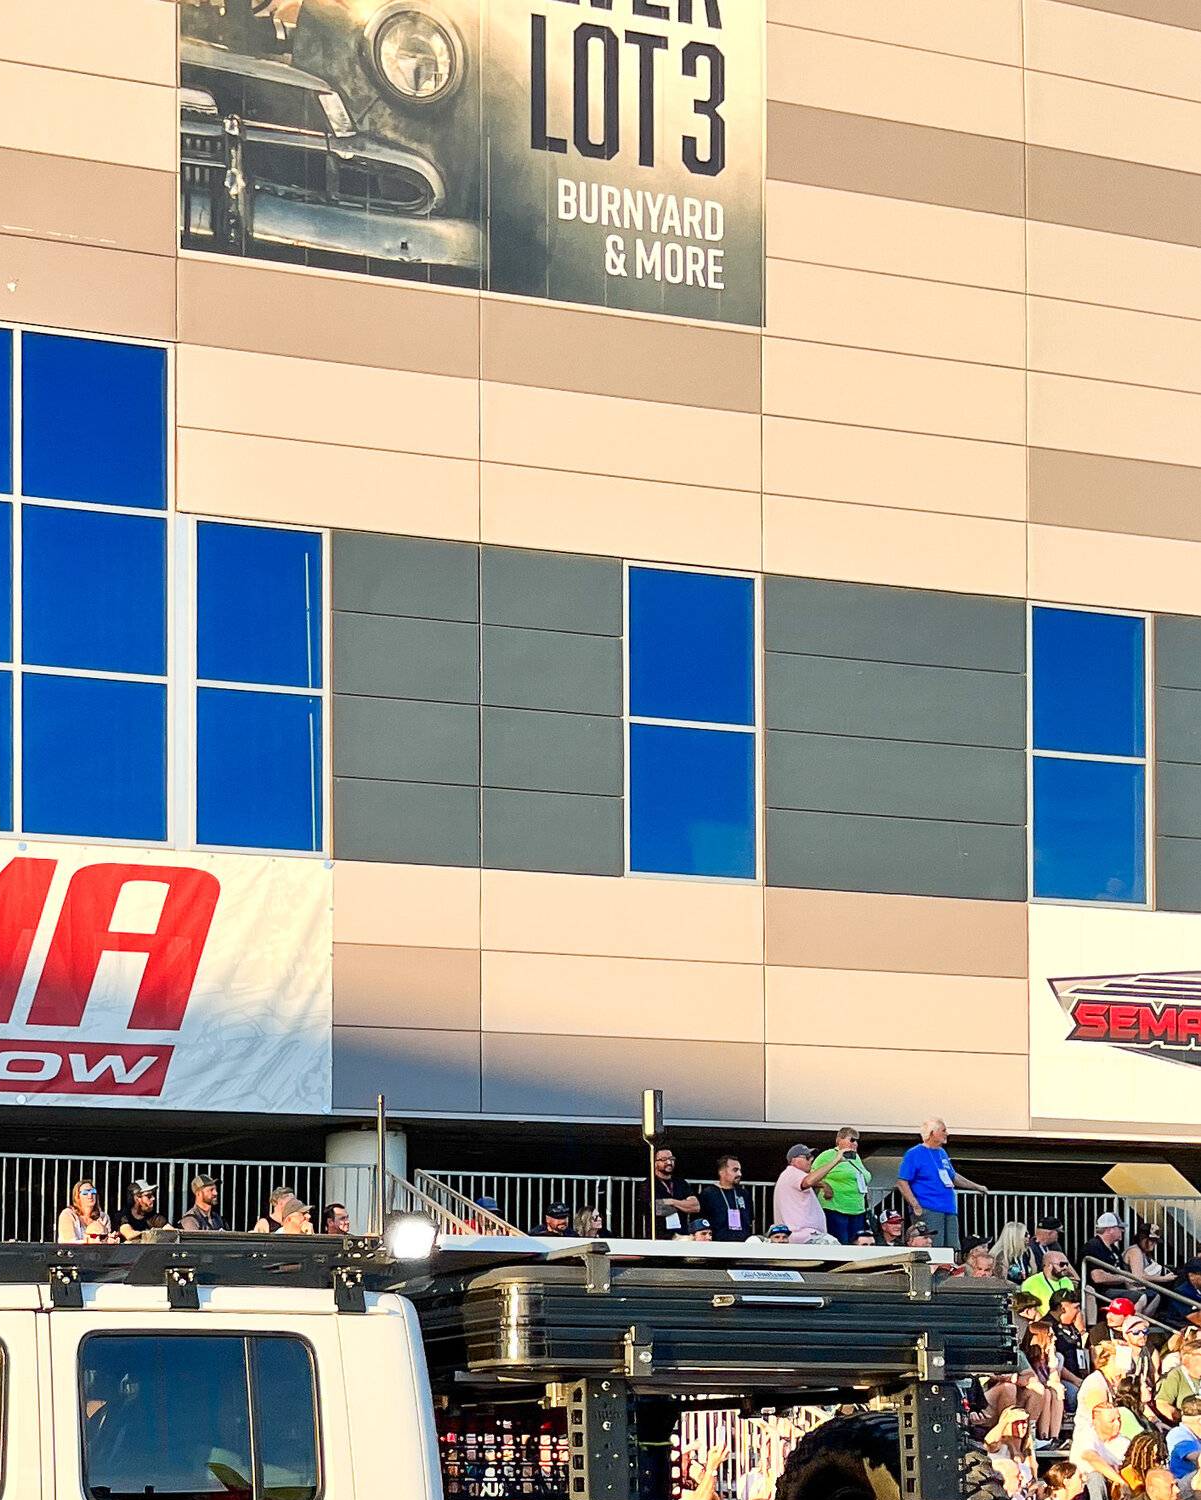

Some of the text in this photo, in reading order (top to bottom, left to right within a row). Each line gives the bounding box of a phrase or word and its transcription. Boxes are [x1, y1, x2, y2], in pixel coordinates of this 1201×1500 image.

[530, 13, 725, 177] LOT 3
[557, 178, 725, 241] BURNYARD
[604, 235, 725, 290] & MORE
[1072, 1002, 1201, 1043] SEMA
